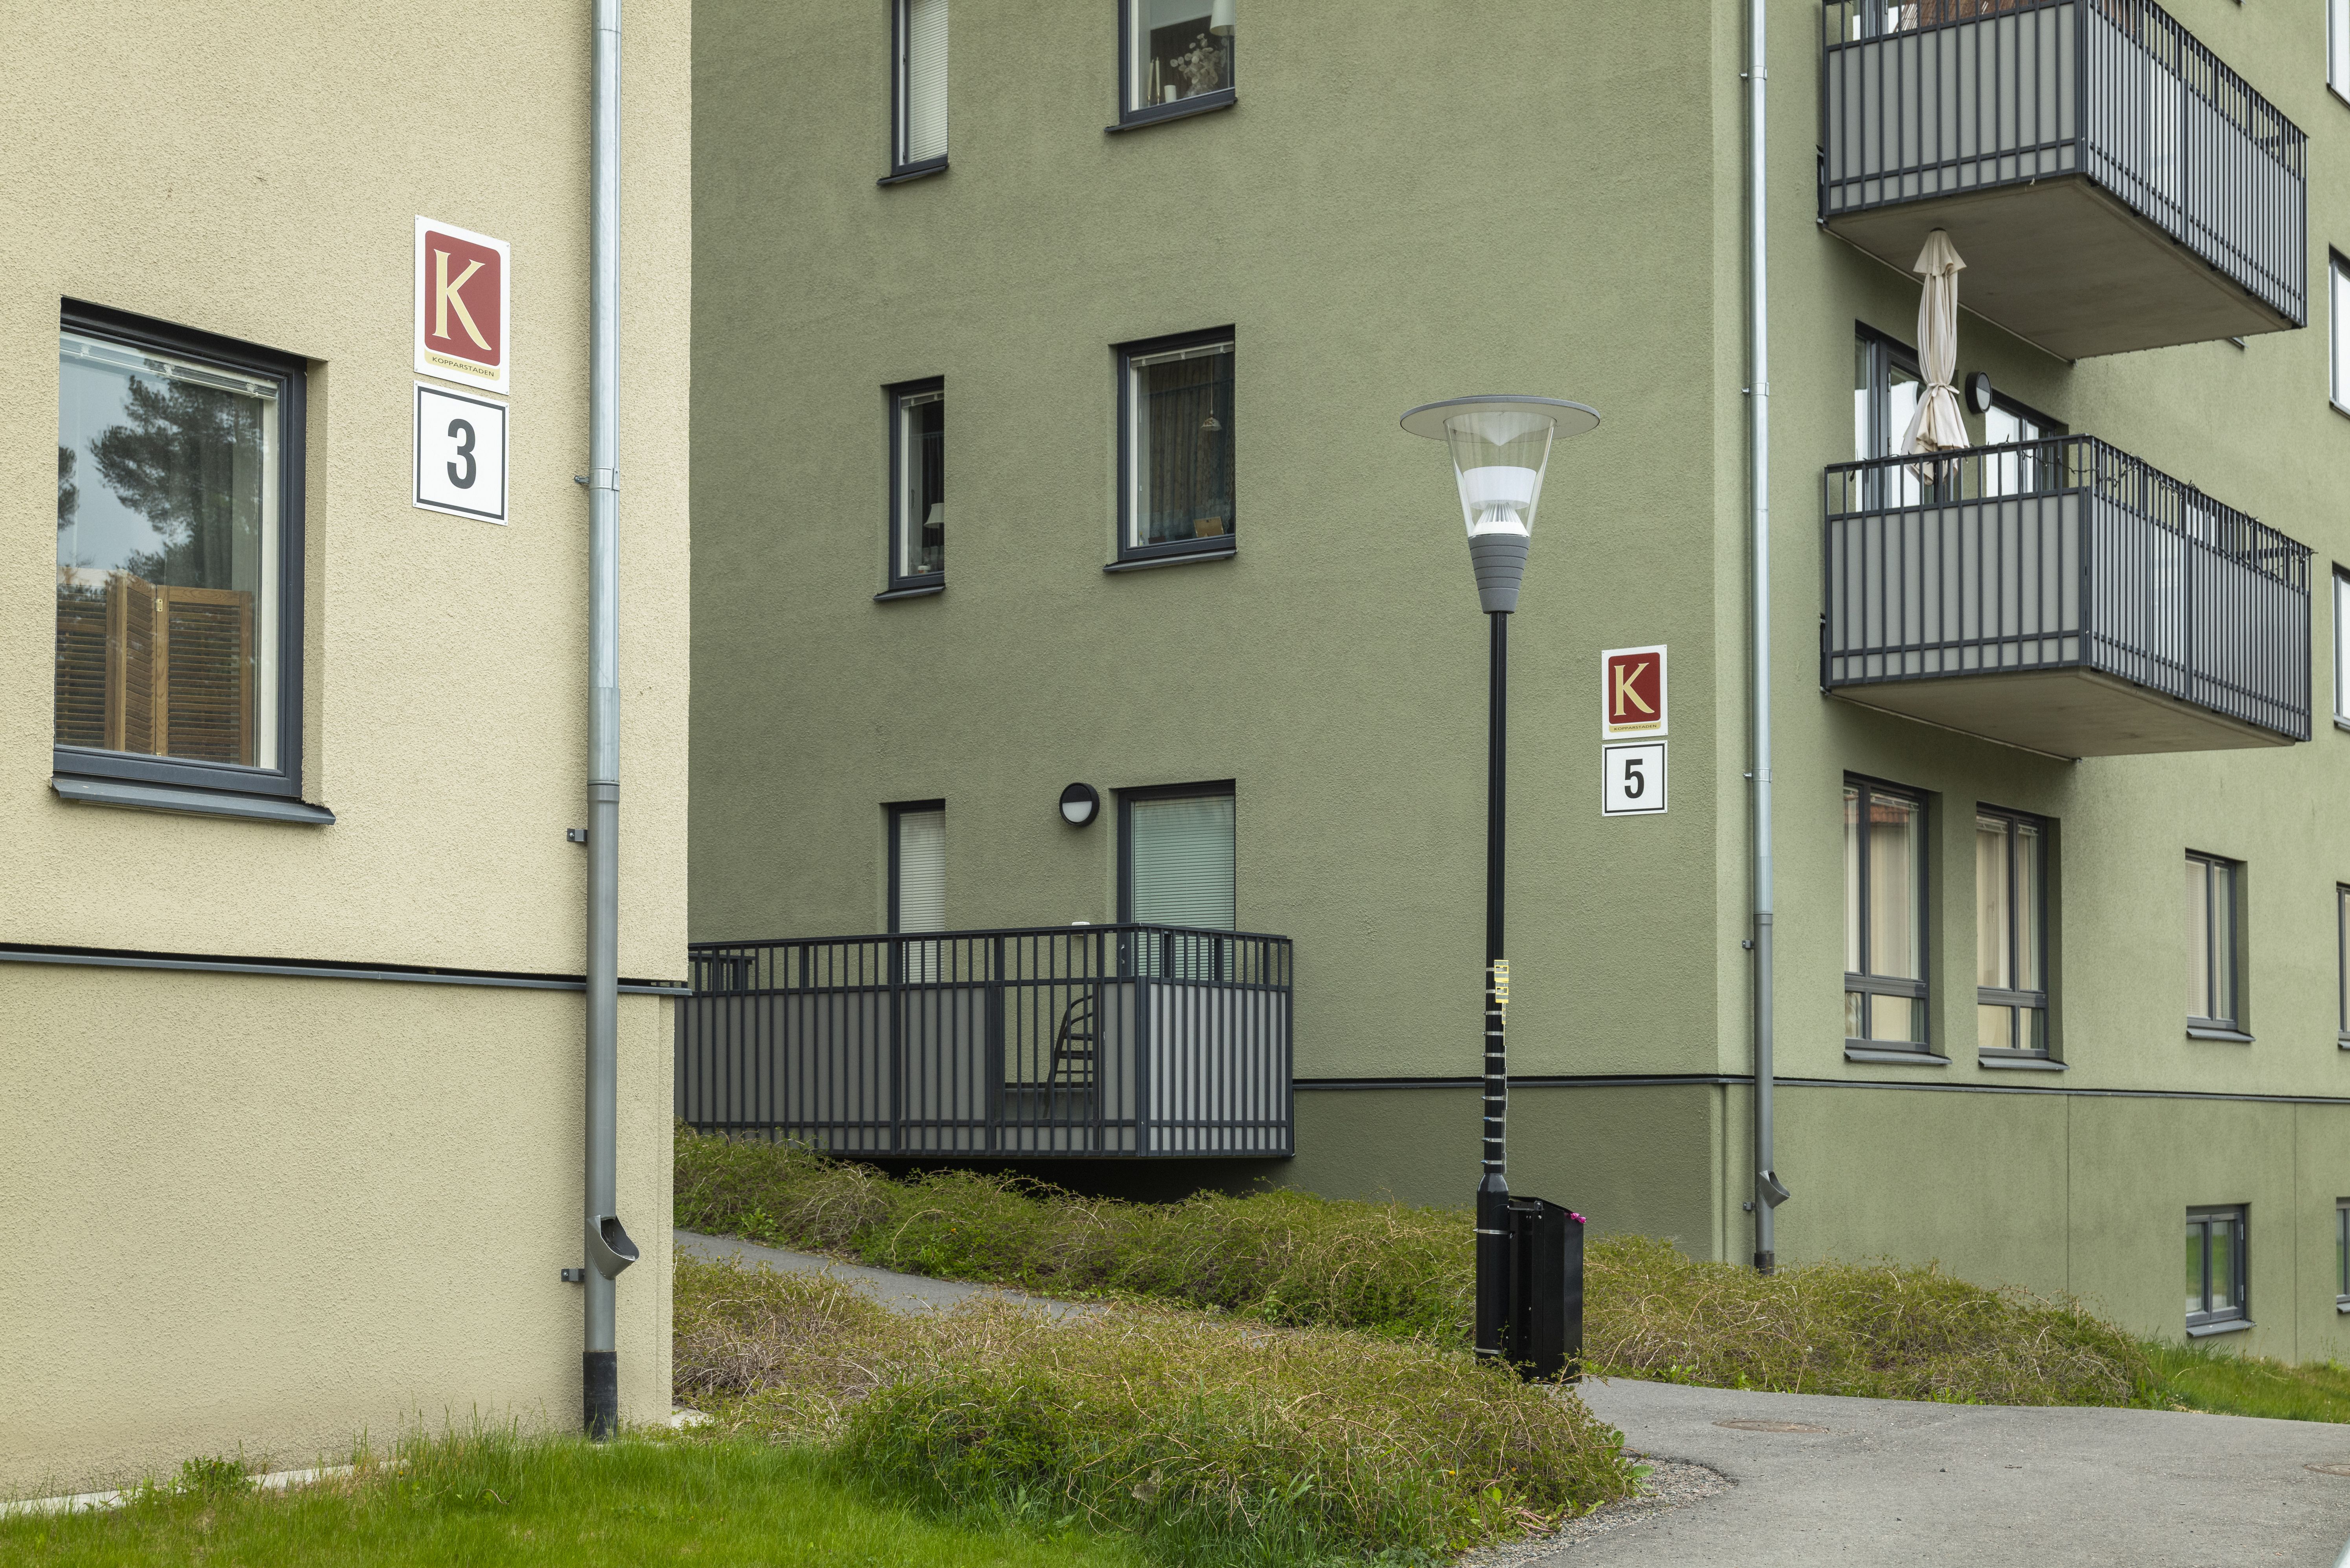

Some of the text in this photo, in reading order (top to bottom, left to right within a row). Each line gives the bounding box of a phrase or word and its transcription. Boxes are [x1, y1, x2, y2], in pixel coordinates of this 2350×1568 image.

[432, 248, 492, 351] K
[432, 356, 494, 377] KOPPARSTADEN
[447, 418, 476, 489] 3
[1613, 663, 1655, 716] K
[1624, 758, 1644, 799] 5
